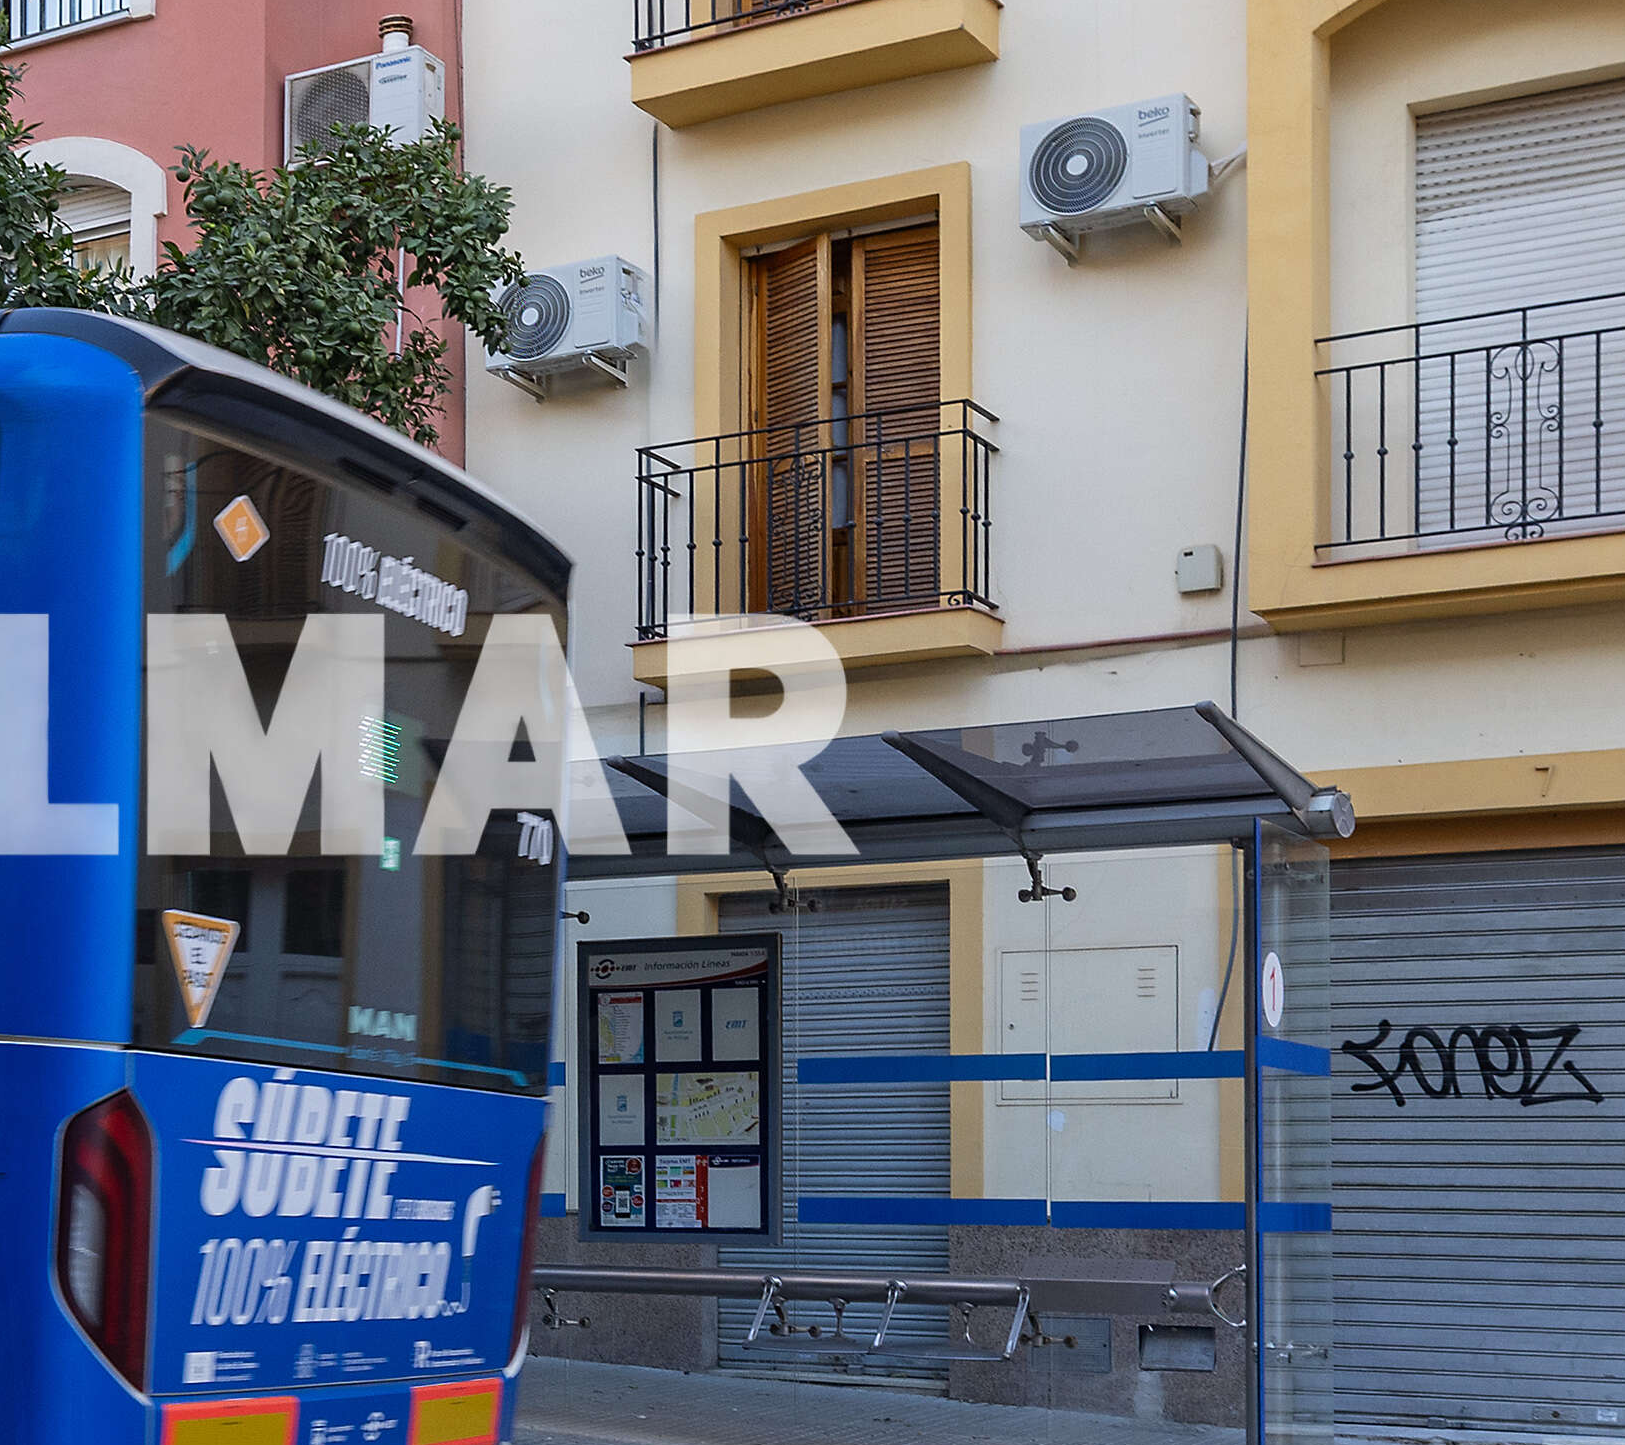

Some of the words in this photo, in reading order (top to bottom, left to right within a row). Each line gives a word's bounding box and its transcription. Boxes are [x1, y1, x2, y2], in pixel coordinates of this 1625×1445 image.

[376, 57, 411, 69] Panasonic
[1138, 107, 1170, 120] beko
[580, 266, 605, 278] beko
[321, 532, 381, 599] 100%
[644, 959, 700, 971] Información
[701, 958, 731, 969] Líneas
[347, 1005, 417, 1042] MAN
[200, 1067, 412, 1219] SÚBETE
[190, 1237, 299, 1326] 100%
[291, 1226, 451, 1323] ELÉCTRICO
